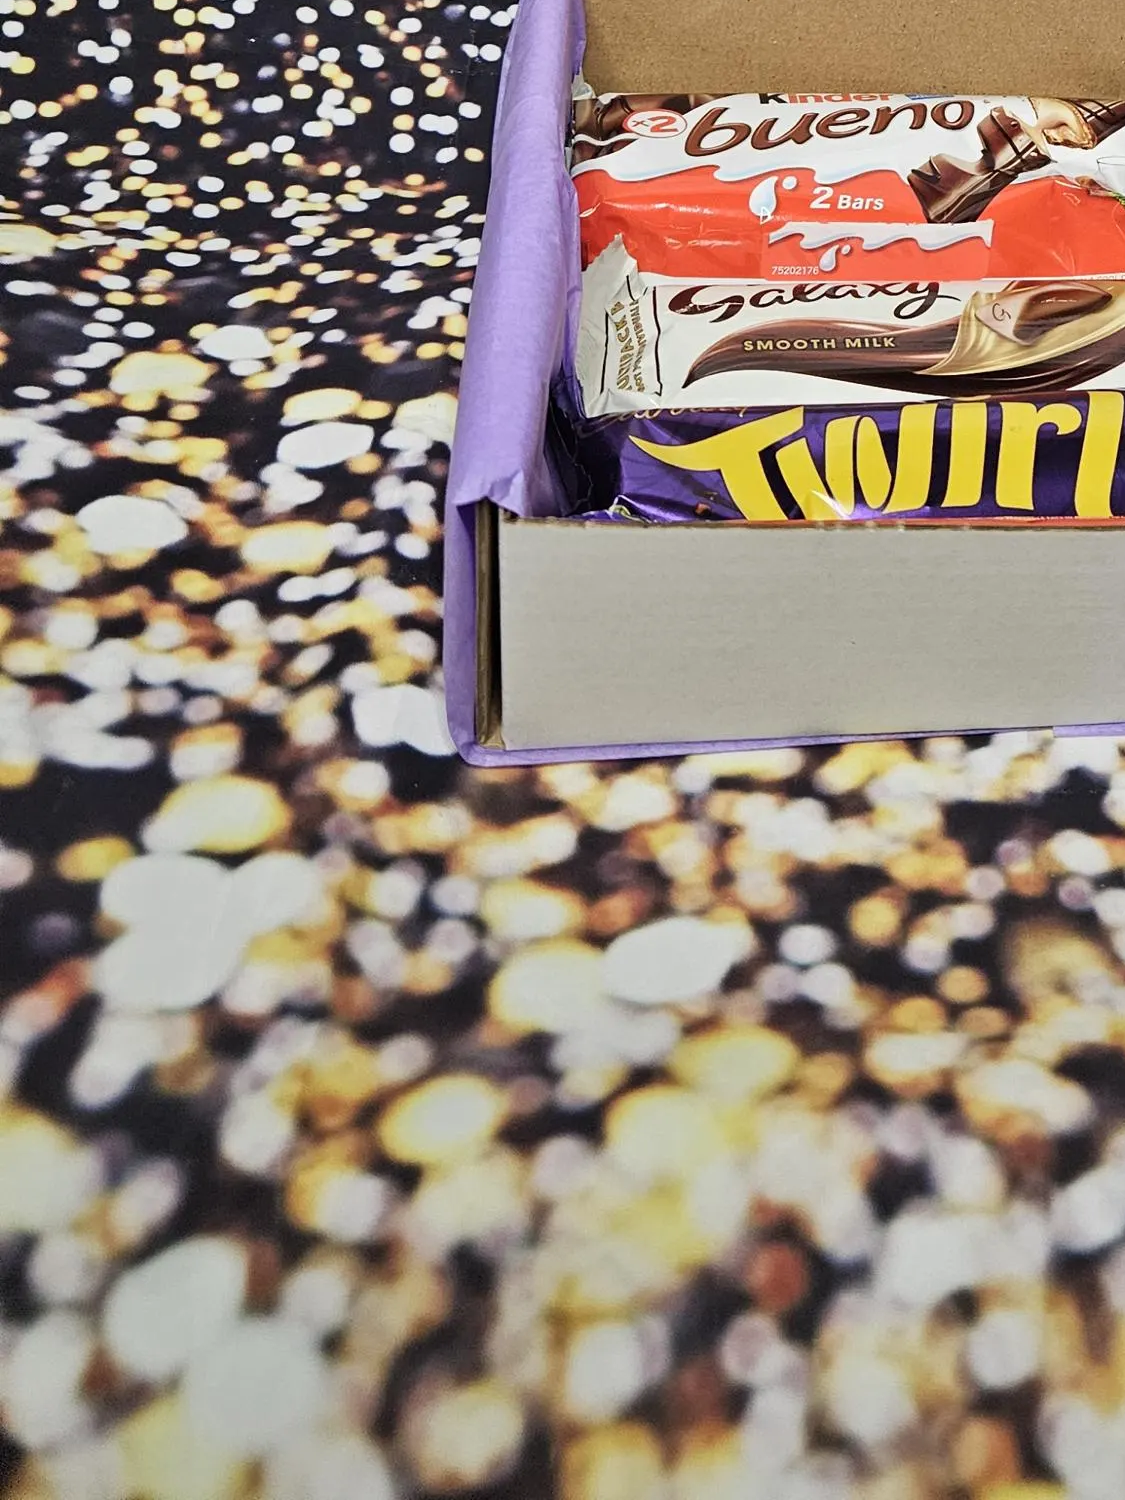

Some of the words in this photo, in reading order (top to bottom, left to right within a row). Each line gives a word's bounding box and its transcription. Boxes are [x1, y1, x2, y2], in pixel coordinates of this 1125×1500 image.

[684, 100, 975, 157] bueno
[809, 186, 834, 209] 2
[837, 194, 884, 210] Bars
[771, 266, 819, 275] 75202176
[743, 337, 837, 352] SMOOTH
[845, 335, 897, 349] MILK
